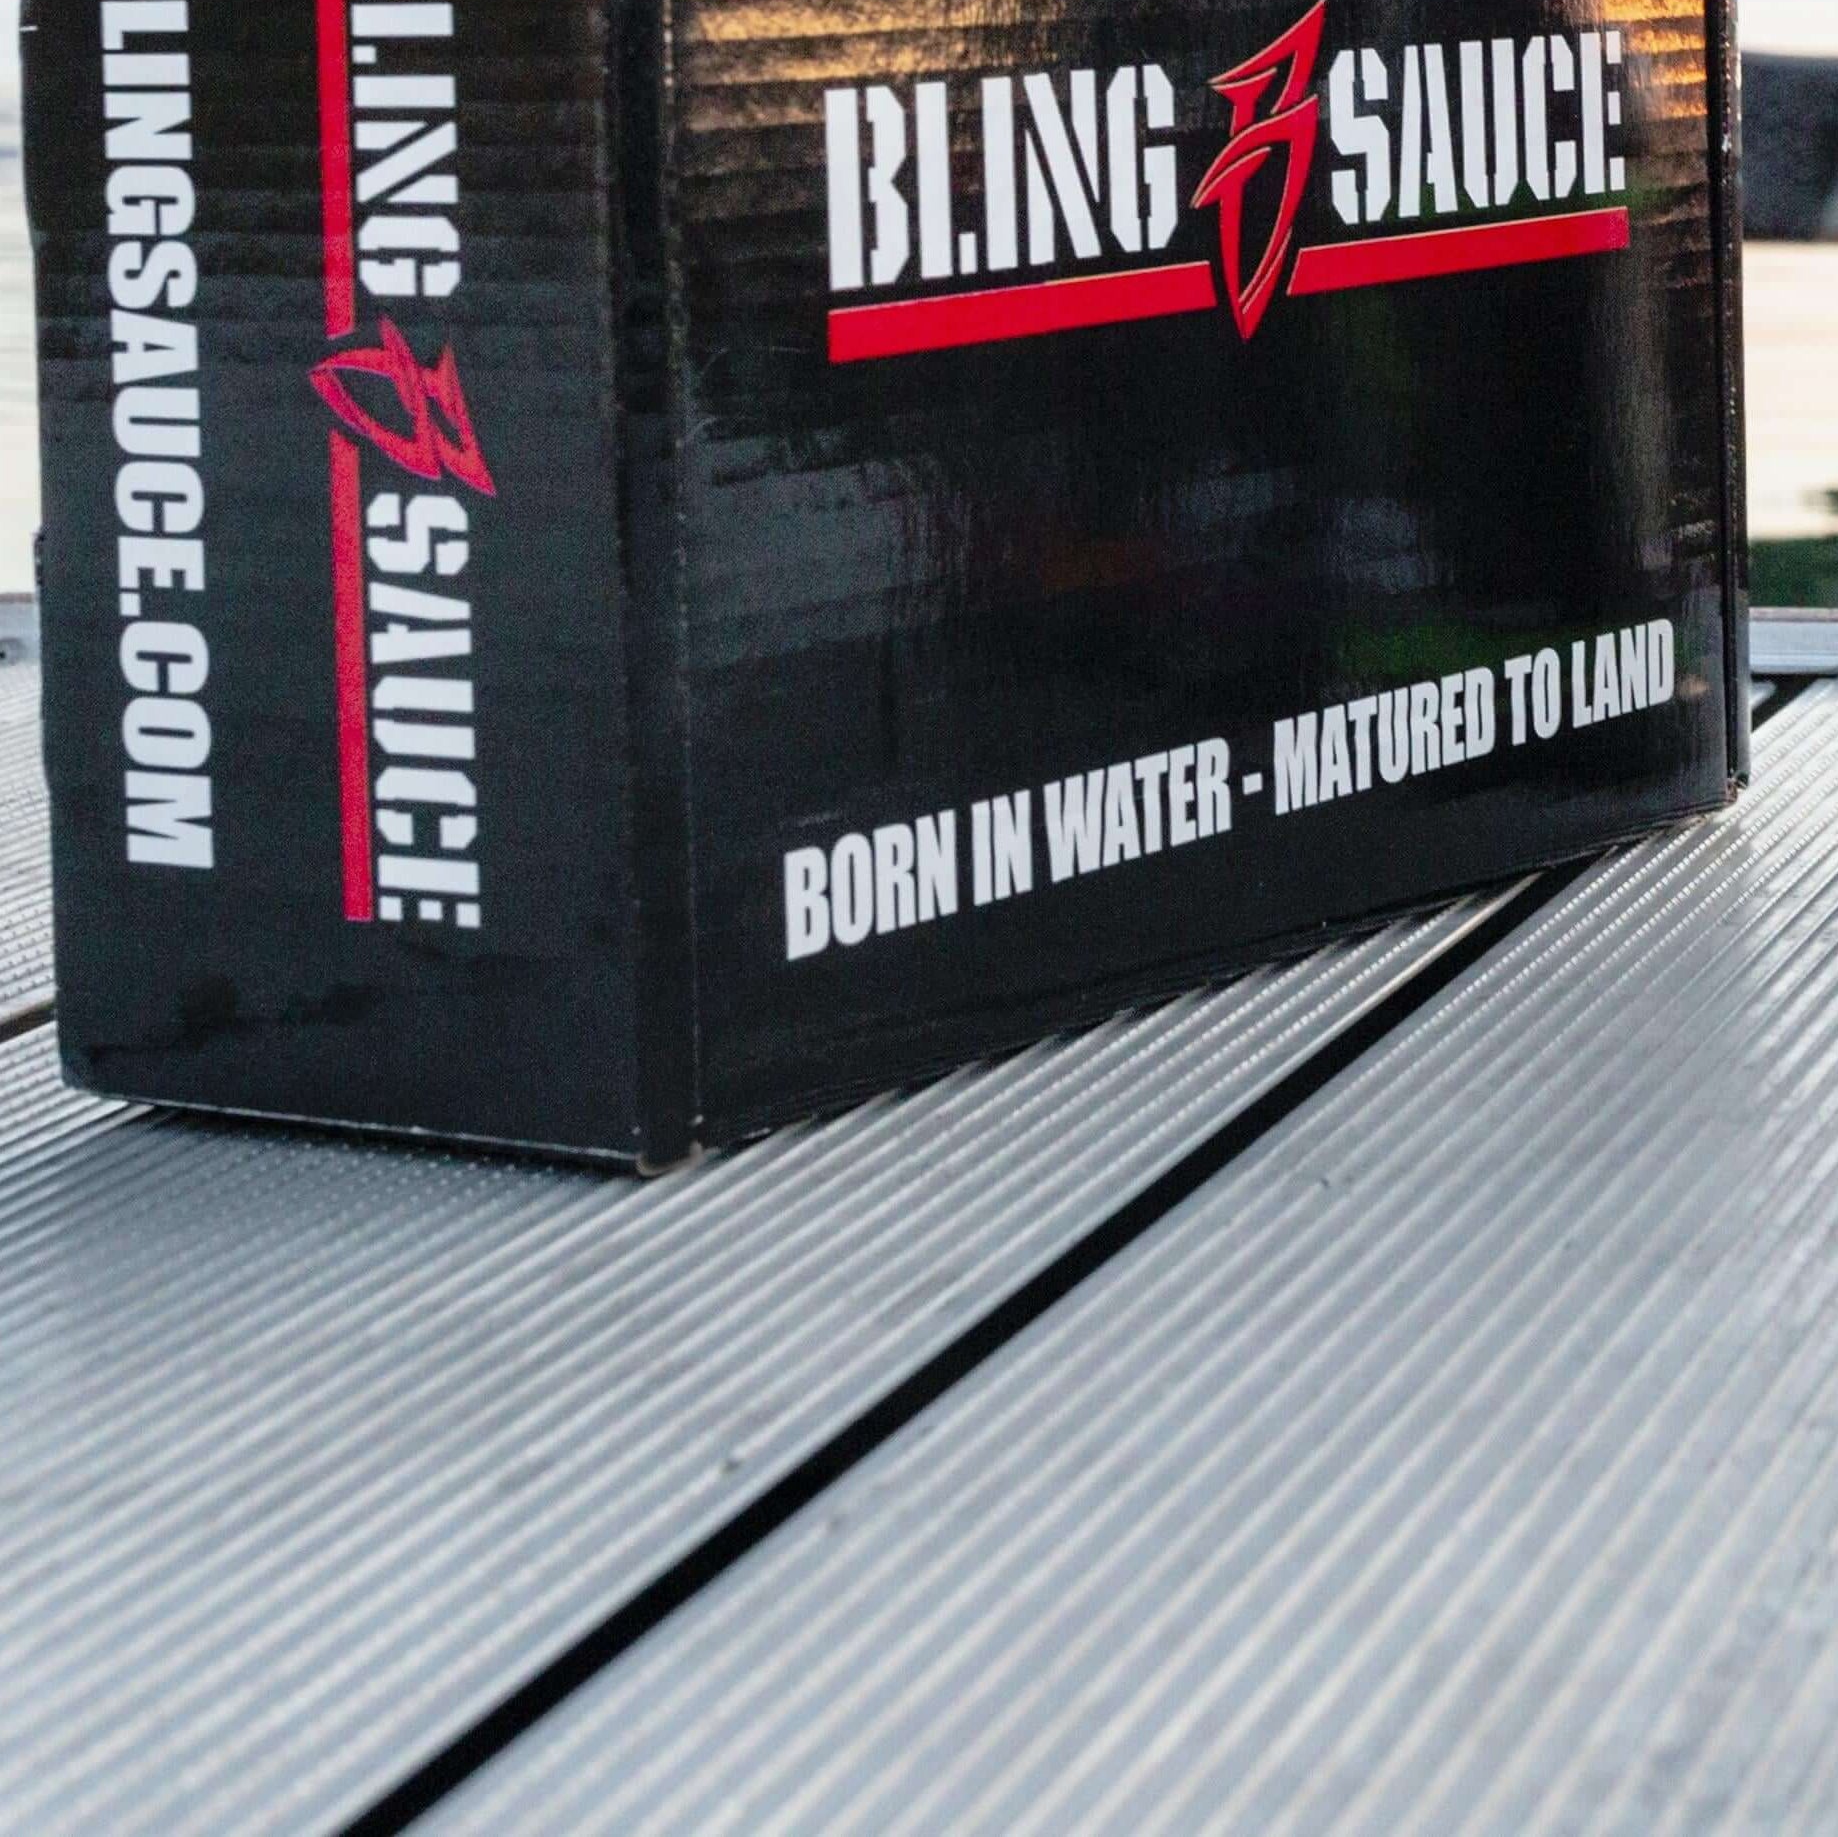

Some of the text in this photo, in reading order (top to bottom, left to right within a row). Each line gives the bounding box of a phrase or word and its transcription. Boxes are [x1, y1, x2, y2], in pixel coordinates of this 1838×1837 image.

[823, 30, 1626, 291] BLING SAUCE
[366, 492, 482, 929] SAUCE
[783, 809, 959, 962] BORN
[970, 789, 1032, 908] IN
[1043, 736, 1232, 883] WATER
[1273, 666, 1496, 816] MATURED
[1504, 647, 1562, 747] TO
[1571, 618, 1675, 730] LAND
